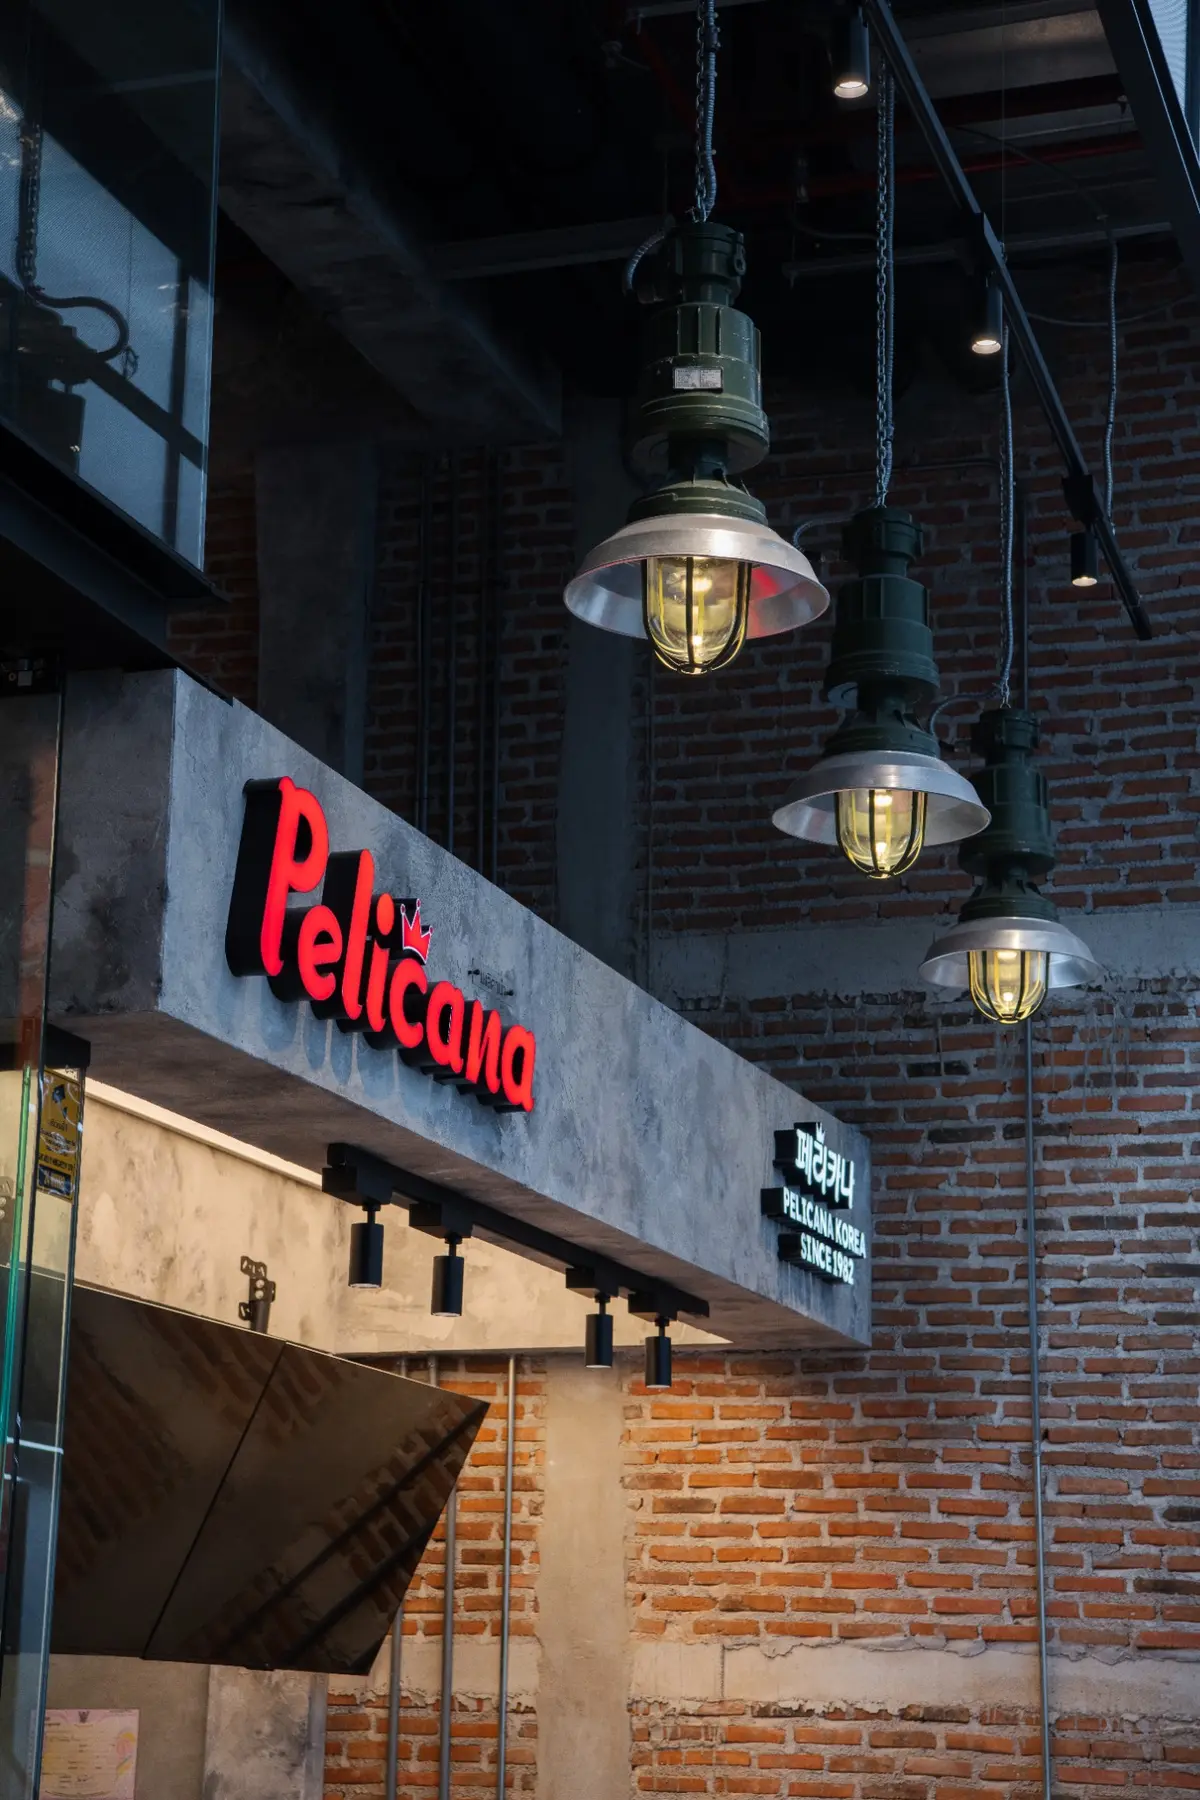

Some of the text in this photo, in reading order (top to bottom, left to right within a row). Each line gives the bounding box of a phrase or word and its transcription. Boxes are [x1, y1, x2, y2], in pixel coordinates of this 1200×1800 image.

[261, 776, 536, 1113] Pelicana
[795, 1128, 855, 1210] 페리카나
[783, 1186, 867, 1259] PELICANA KOREA
[800, 1232, 855, 1286] SINCE 1982
